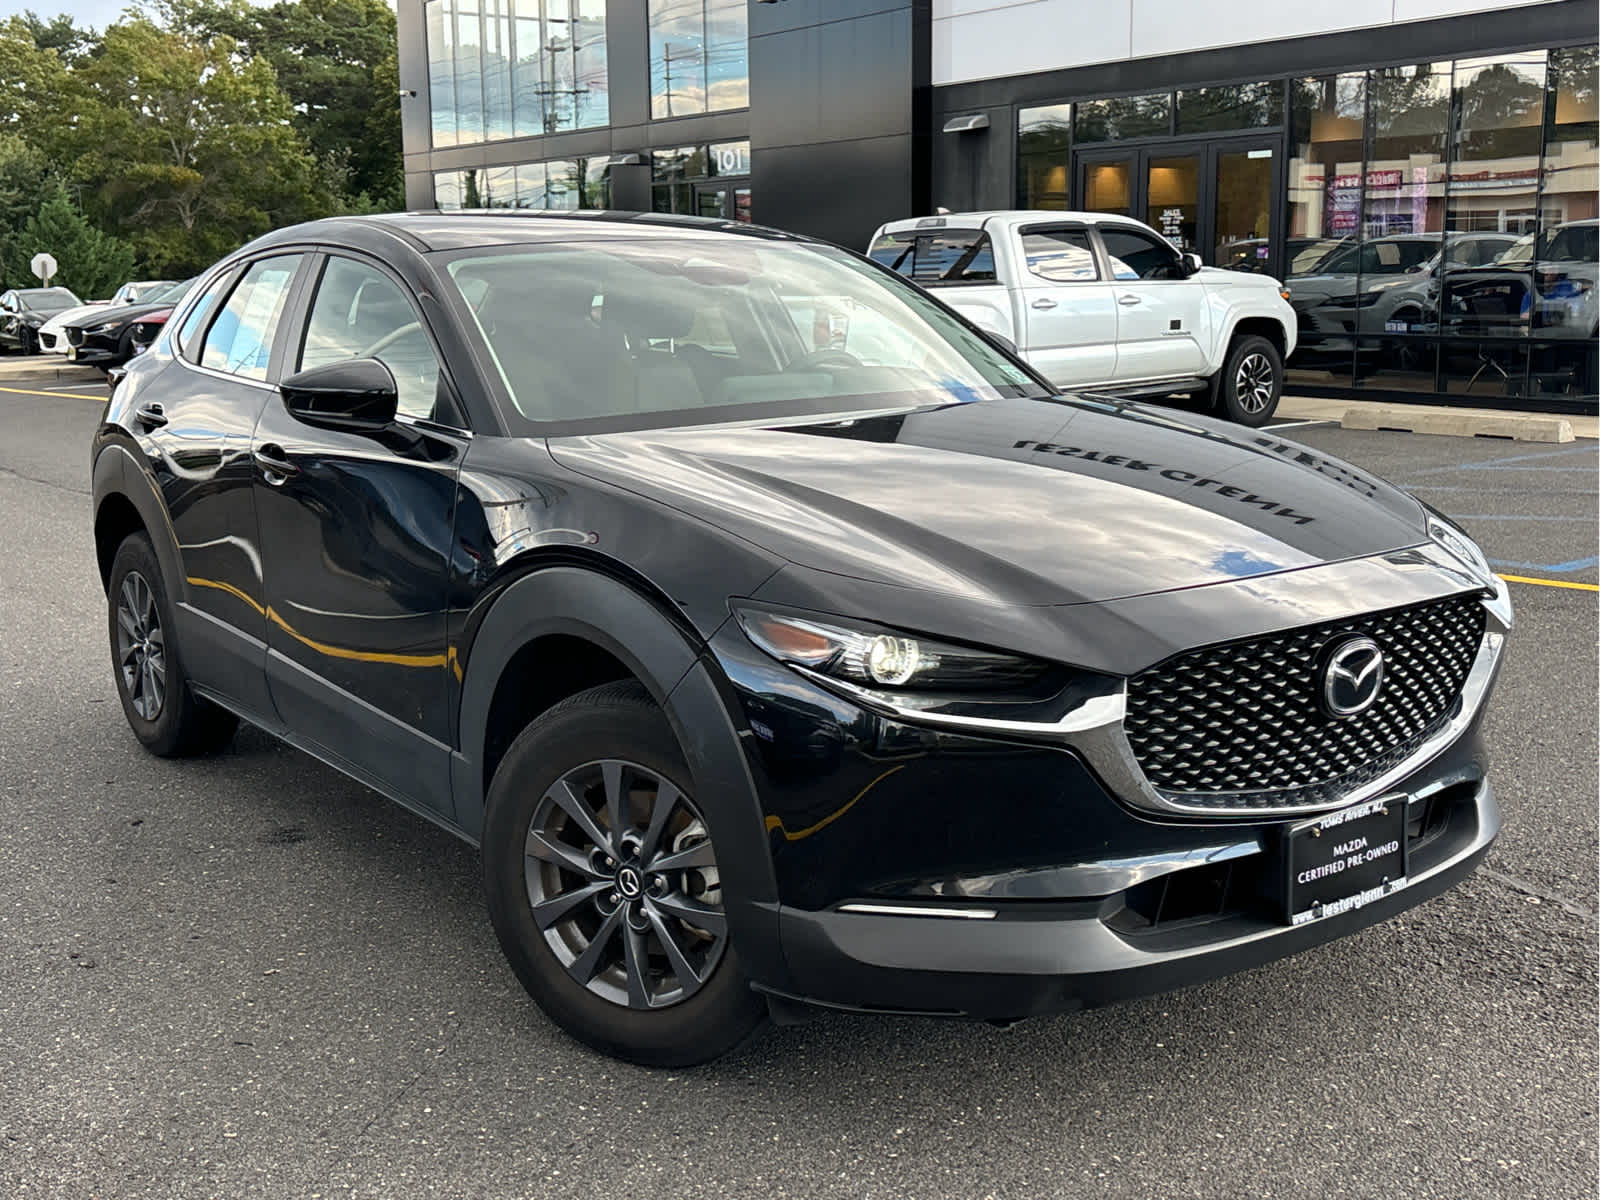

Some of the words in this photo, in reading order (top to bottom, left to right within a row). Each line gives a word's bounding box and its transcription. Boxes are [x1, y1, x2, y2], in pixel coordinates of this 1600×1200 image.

[717, 149, 743, 171] 101
[1333, 837, 1368, 857] MAZDA
[1298, 860, 1345, 884] CERTIFIED
[1347, 840, 1399, 868] PRE-OWNED
[1322, 885, 1384, 917] lesterglenn
